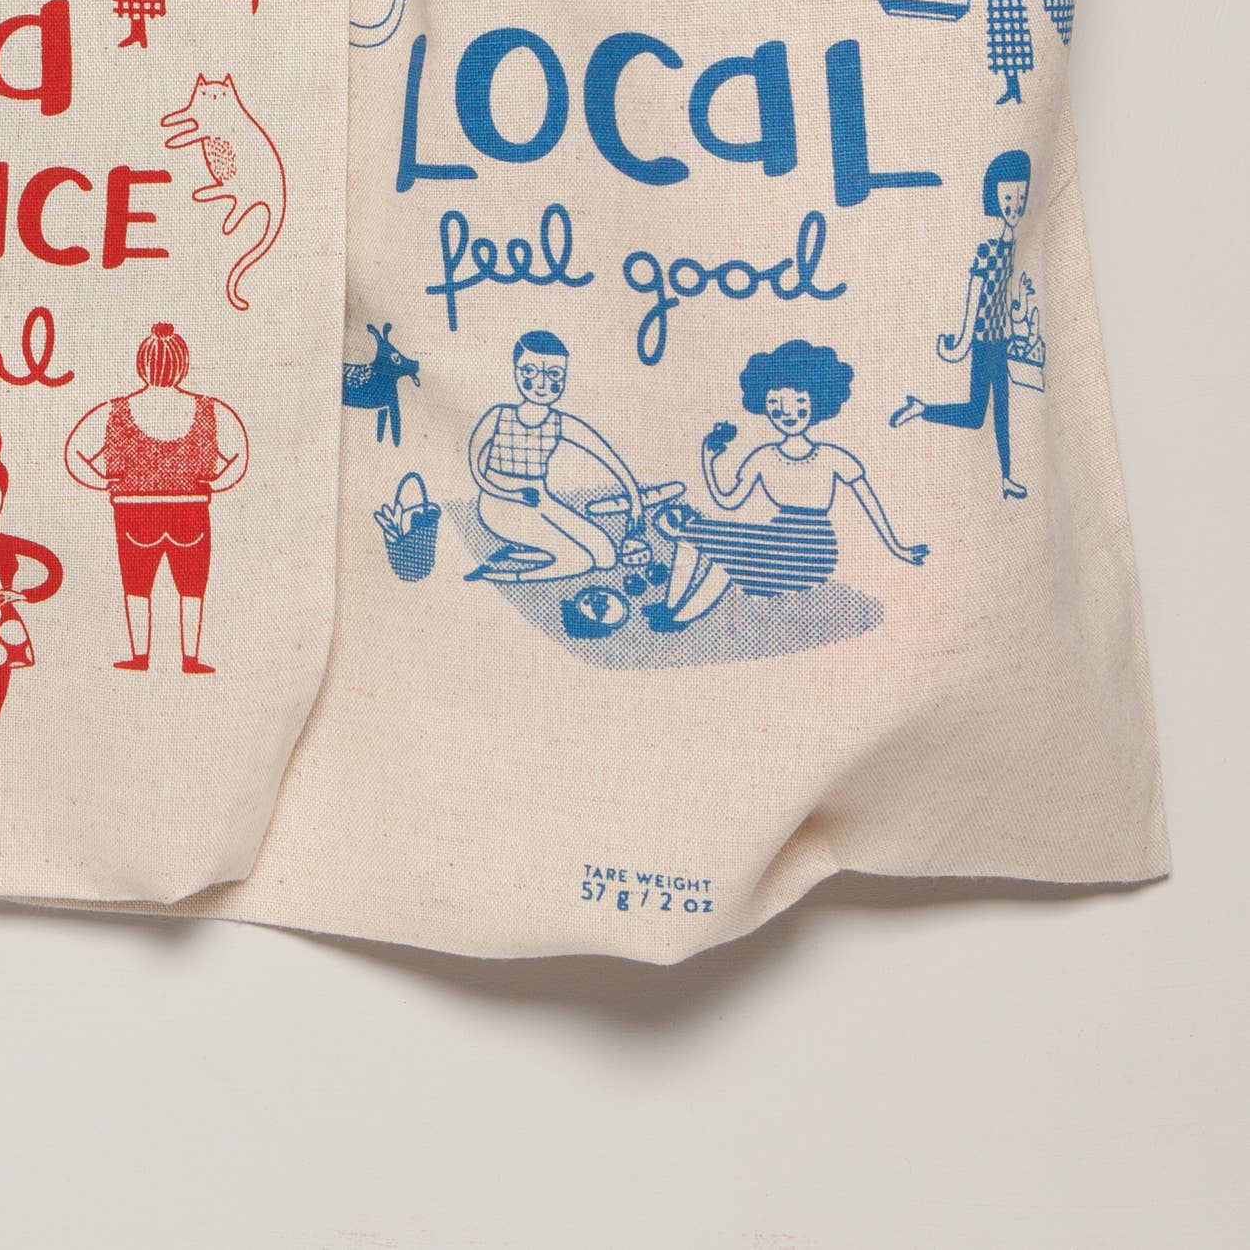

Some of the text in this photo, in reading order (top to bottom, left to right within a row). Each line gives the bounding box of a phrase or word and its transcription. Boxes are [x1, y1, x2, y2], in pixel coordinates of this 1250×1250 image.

[426, 203, 847, 366] feel good
[584, 864, 712, 893] TARE WEIGHT
[581, 881, 606, 902] 57
[617, 890, 630, 911] g
[660, 892, 672, 911] 2
